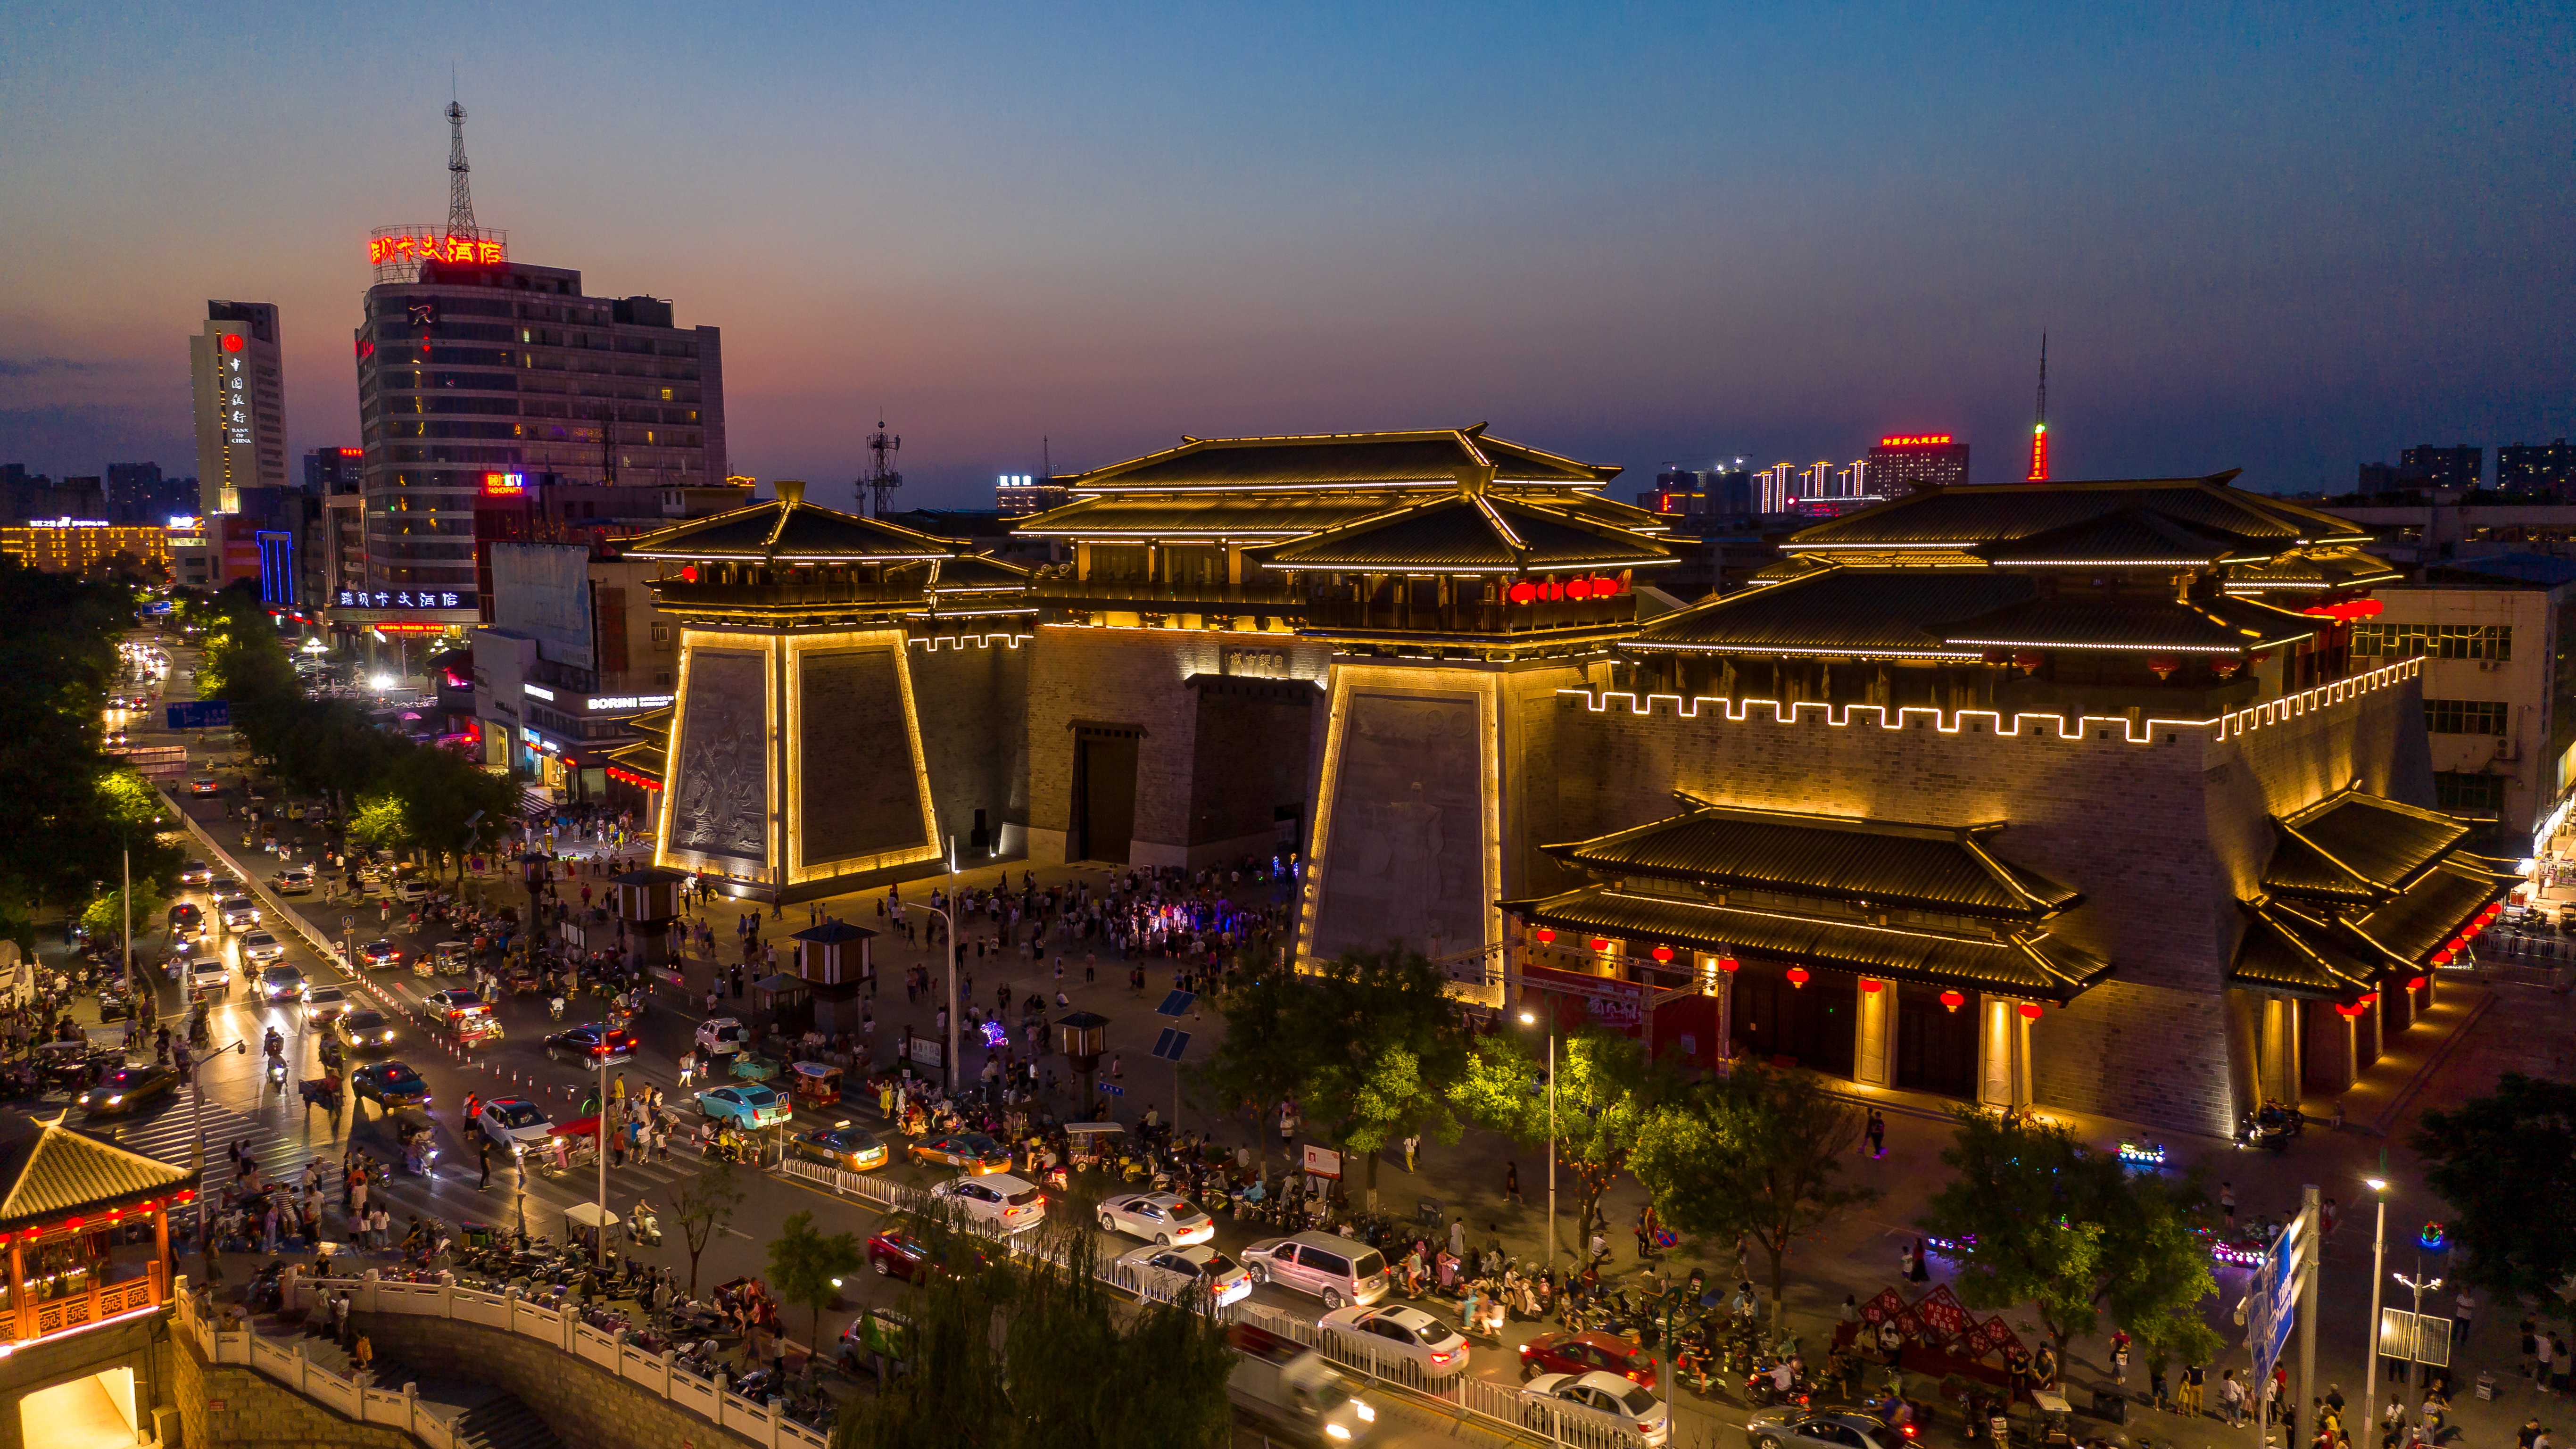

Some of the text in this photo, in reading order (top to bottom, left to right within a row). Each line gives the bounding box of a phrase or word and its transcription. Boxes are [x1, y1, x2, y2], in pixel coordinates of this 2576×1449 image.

[341, 592, 458, 607] 瑞贝卡大酒店
[588, 697, 638, 709] BORINI
